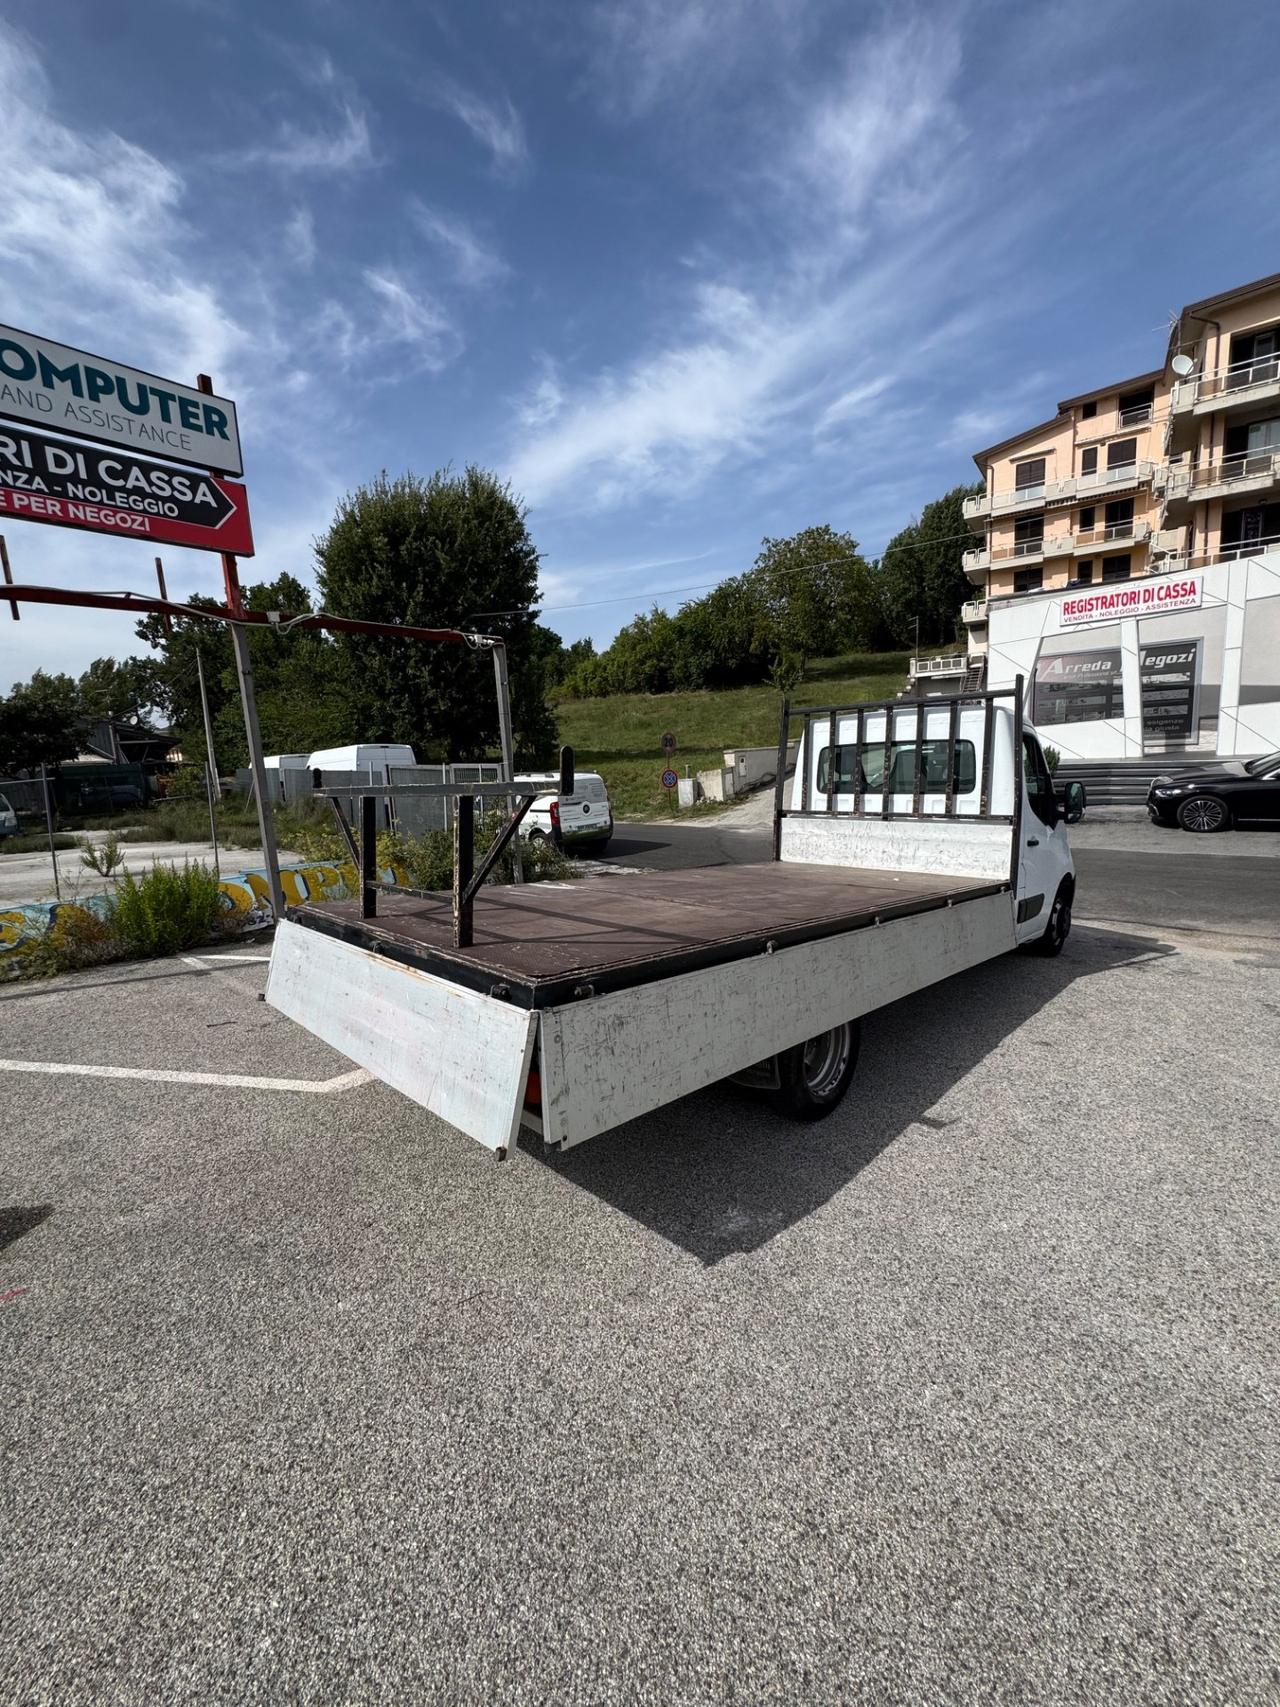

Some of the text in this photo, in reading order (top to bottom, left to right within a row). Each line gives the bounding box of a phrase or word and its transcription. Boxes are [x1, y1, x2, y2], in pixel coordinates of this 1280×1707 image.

[0, 338, 230, 441] OMPUTER
[0, 384, 192, 451] AND ASSISTANCE
[44, 445, 88, 480] DI
[98, 459, 218, 508] CASSA
[12, 492, 63, 518] PER
[69, 503, 151, 532] NEGOZI
[68, 481, 179, 518] NOLEGGIO
[1063, 581, 1197, 616] REGISTRATORI DI CASSA
[1063, 613, 1094, 623] VENDITA
[1100, 607, 1139, 618] NOLEGGIO
[1145, 598, 1196, 611] ASSISTENZA
[1042, 658, 1112, 678] Arreda
